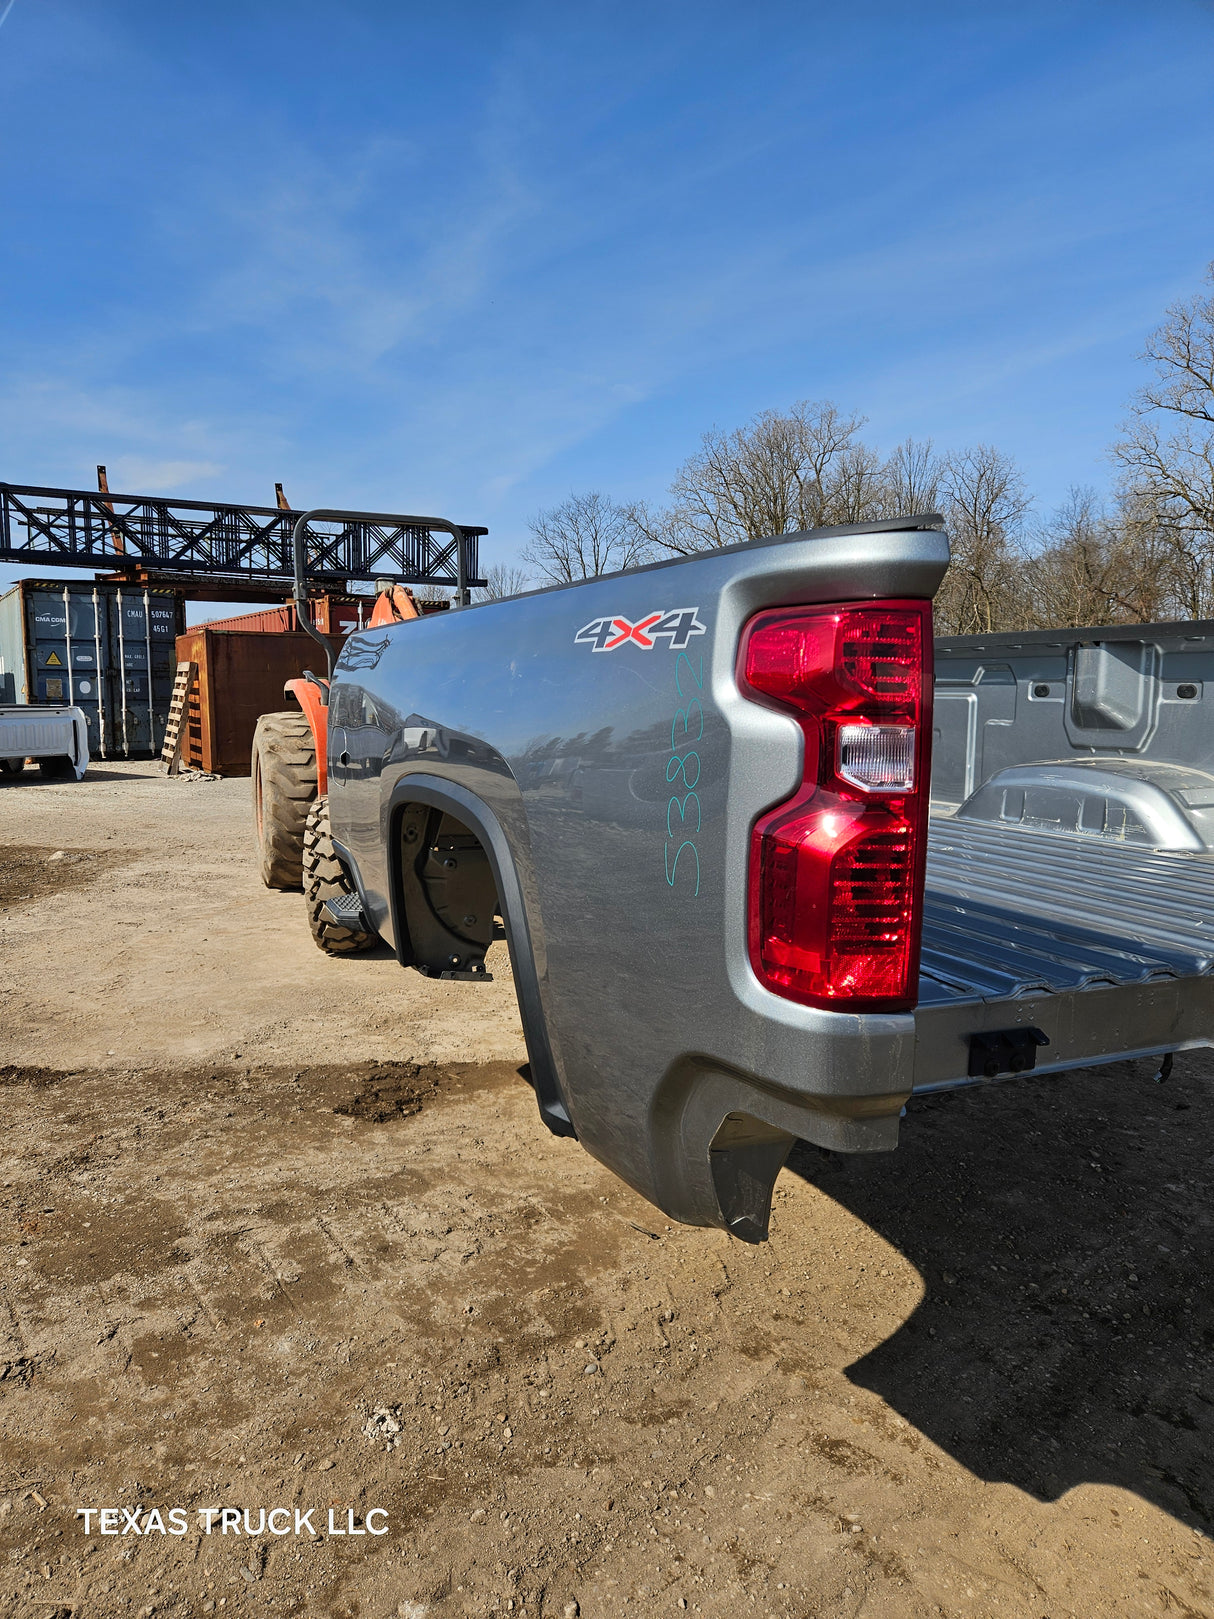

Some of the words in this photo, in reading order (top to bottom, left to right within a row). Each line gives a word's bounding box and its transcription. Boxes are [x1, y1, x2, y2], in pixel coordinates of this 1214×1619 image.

[127, 610, 143, 618] CMAU
[152, 625, 169, 633] 45G1
[664, 652, 703, 897] 53832
